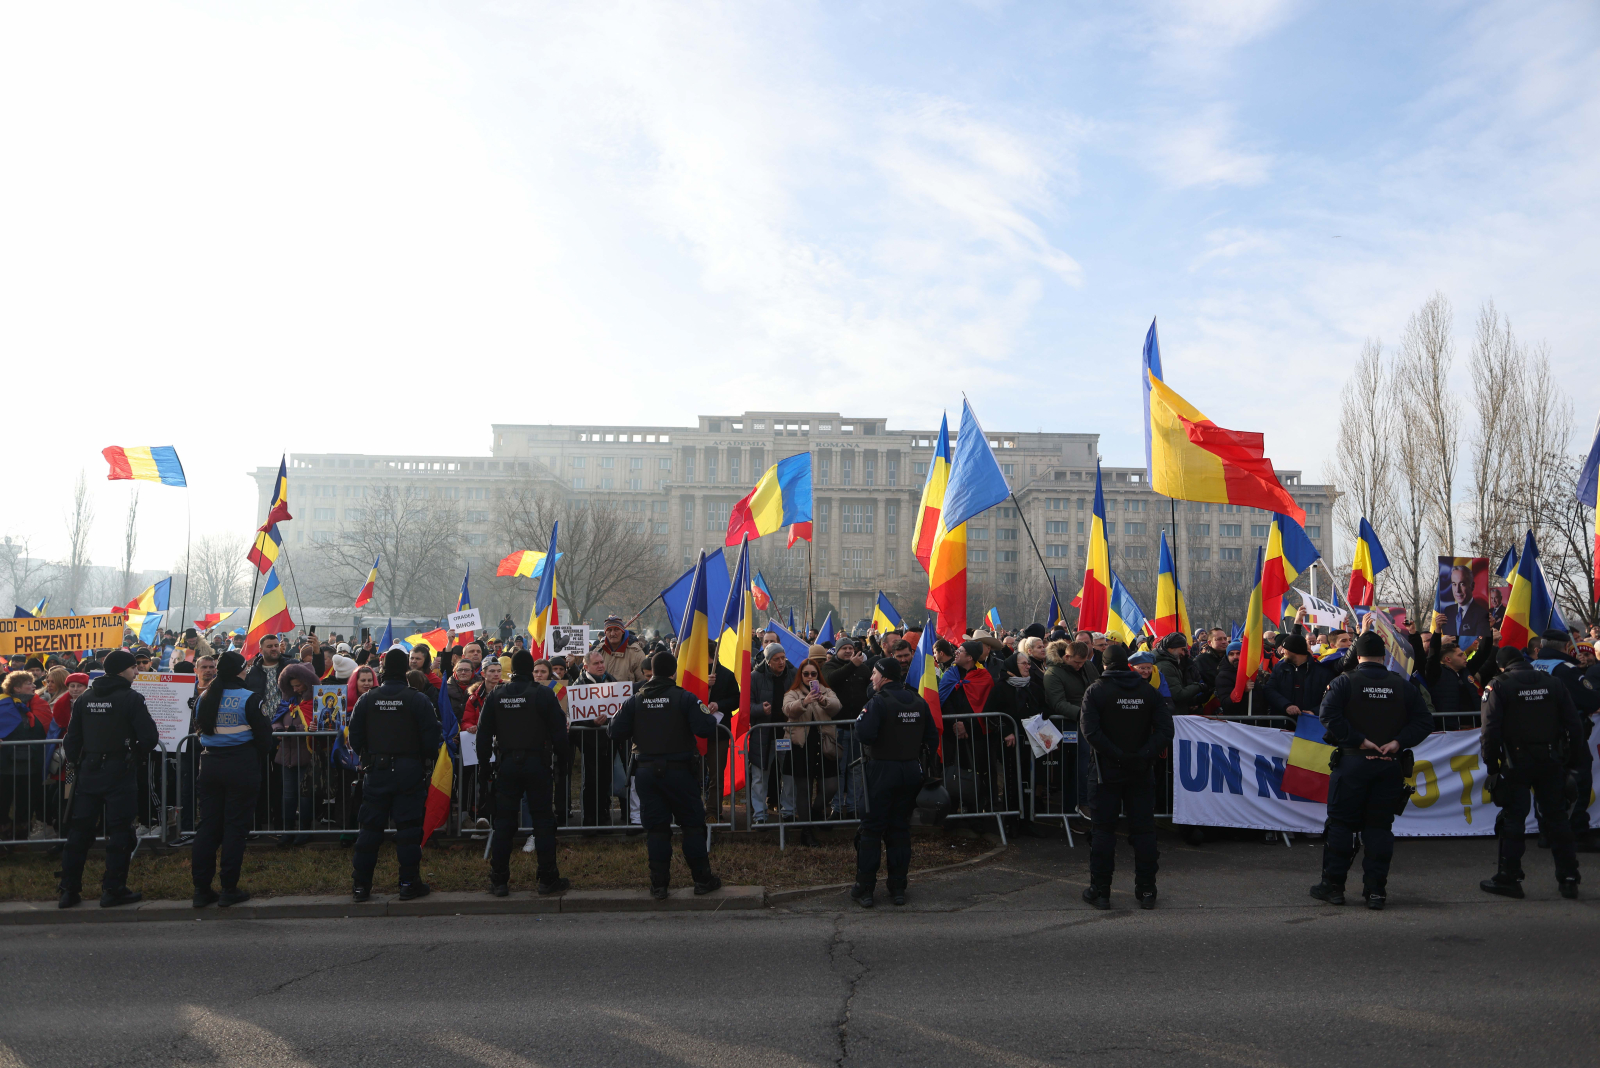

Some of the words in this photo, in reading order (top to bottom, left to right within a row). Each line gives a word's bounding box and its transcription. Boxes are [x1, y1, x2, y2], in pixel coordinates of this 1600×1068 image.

[1308, 596, 1342, 619] IAȘI
[92, 615, 123, 628] ITALIA
[453, 613, 475, 622] ORADEA
[455, 620, 476, 629] BIHOR
[14, 633, 82, 653] PREZENTI
[568, 685, 619, 702] TURUL
[622, 684, 632, 697] 2
[1362, 686, 1394, 694] JANDARMERIA
[1517, 688, 1549, 697] JANDARMERIA
[1178, 738, 1244, 797] UN
